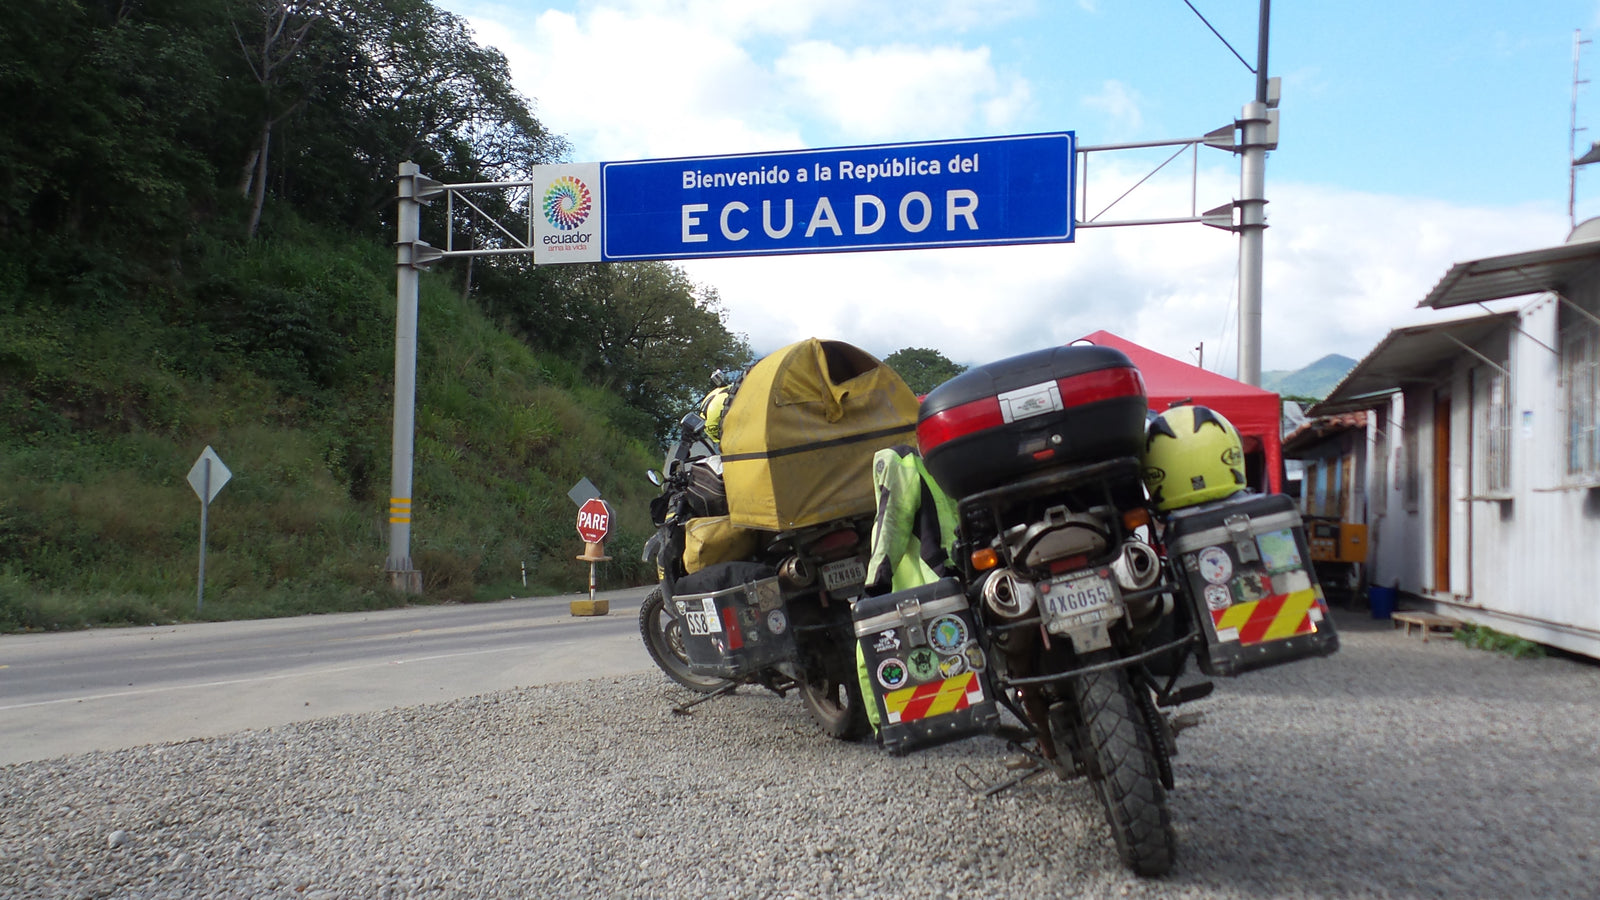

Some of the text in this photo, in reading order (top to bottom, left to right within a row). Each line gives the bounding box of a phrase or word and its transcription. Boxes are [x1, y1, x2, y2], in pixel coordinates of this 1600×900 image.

[682, 153, 979, 189] Bienvenido a la República del
[681, 188, 979, 243] ECUADOR
[543, 231, 592, 244] ecuador
[578, 511, 607, 531] PARE
[1049, 586, 1107, 614] 4XG055
